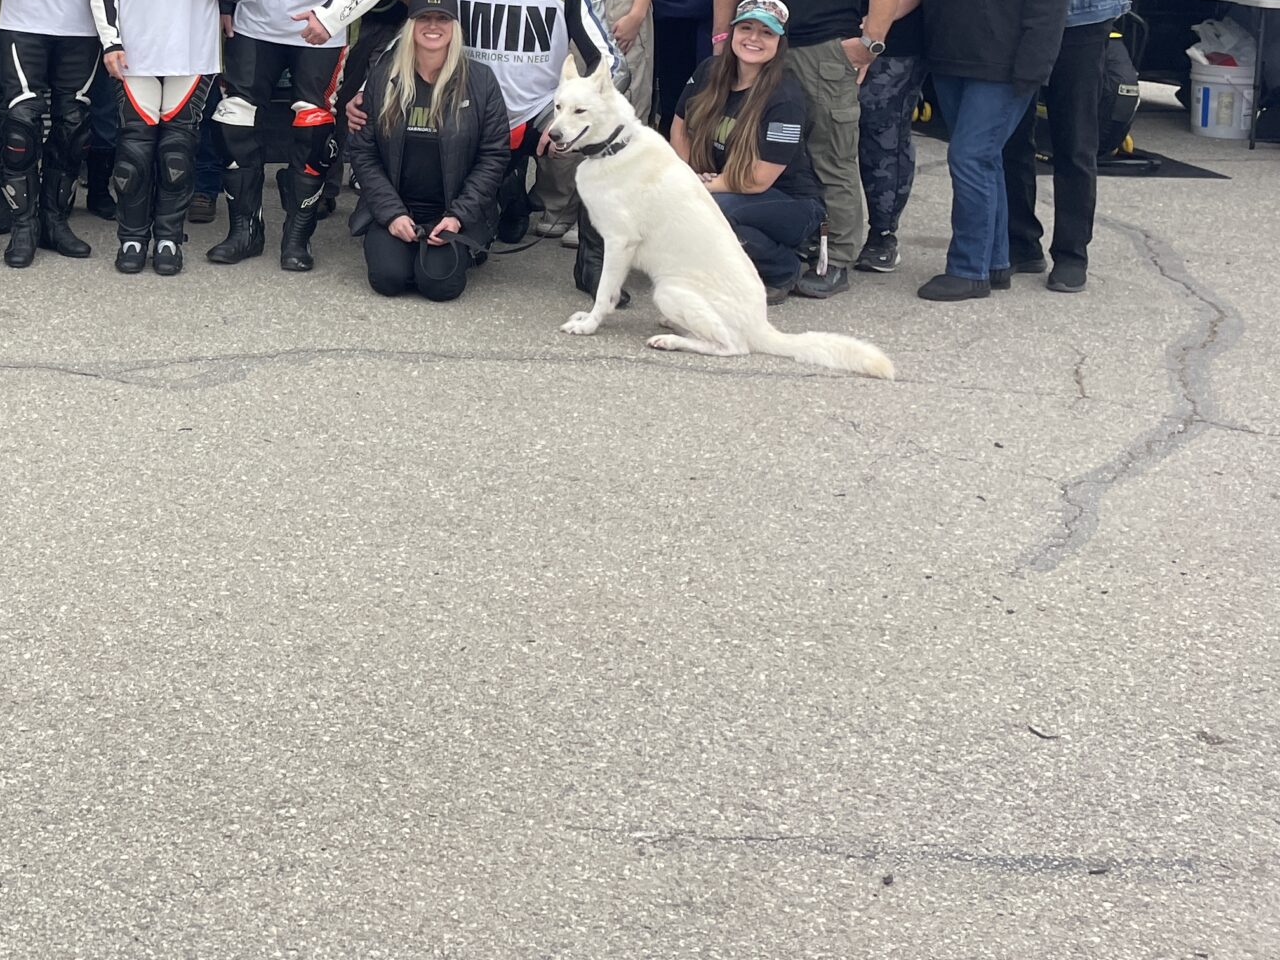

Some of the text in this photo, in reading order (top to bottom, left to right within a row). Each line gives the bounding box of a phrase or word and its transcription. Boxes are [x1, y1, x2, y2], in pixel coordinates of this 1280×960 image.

[460, 0, 557, 52] WIN
[513, 54, 523, 63] IN
[527, 54, 550, 63] NEED
